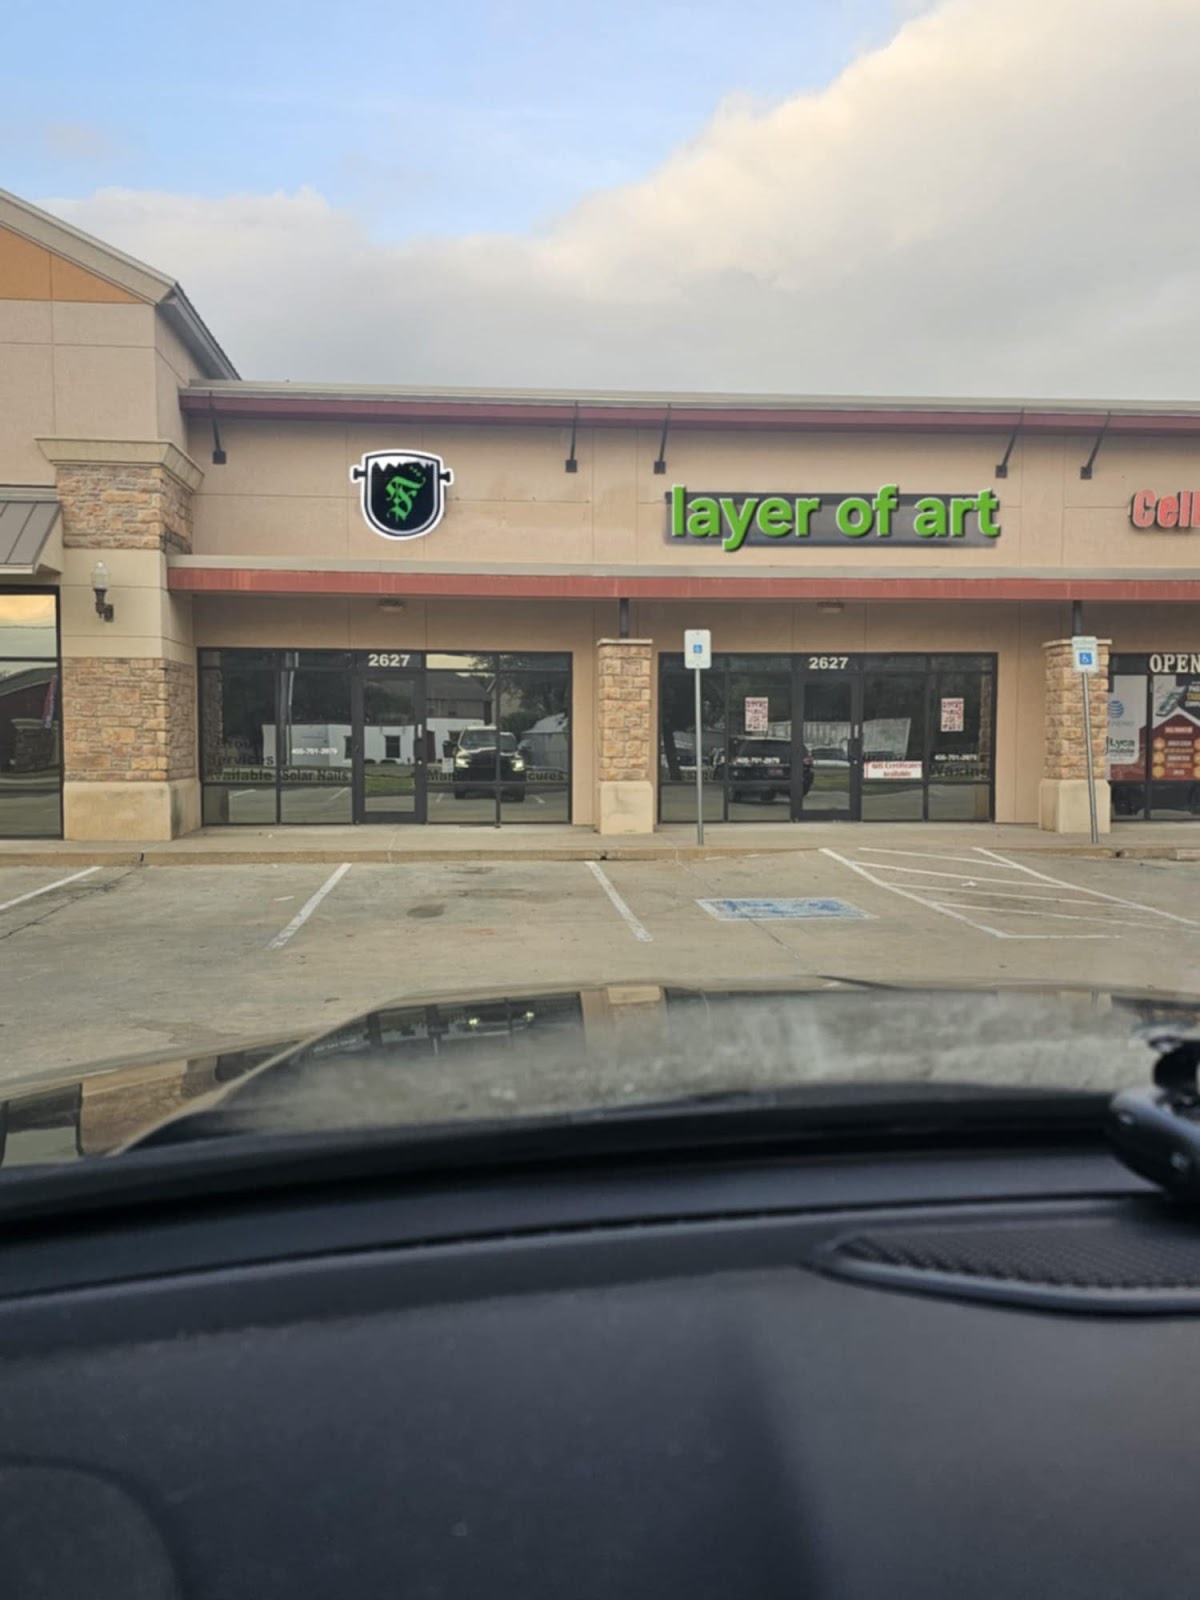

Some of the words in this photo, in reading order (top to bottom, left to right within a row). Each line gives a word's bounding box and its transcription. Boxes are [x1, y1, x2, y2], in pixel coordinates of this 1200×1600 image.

[670, 484, 820, 551] layer
[835, 484, 899, 539] of
[912, 487, 1001, 539] art
[368, 654, 411, 668] 2627
[808, 656, 849, 670] 2627
[1149, 653, 1200, 673] OPEN
[1109, 738, 1135, 749] Lyca
[282, 768, 313, 781] Solar
